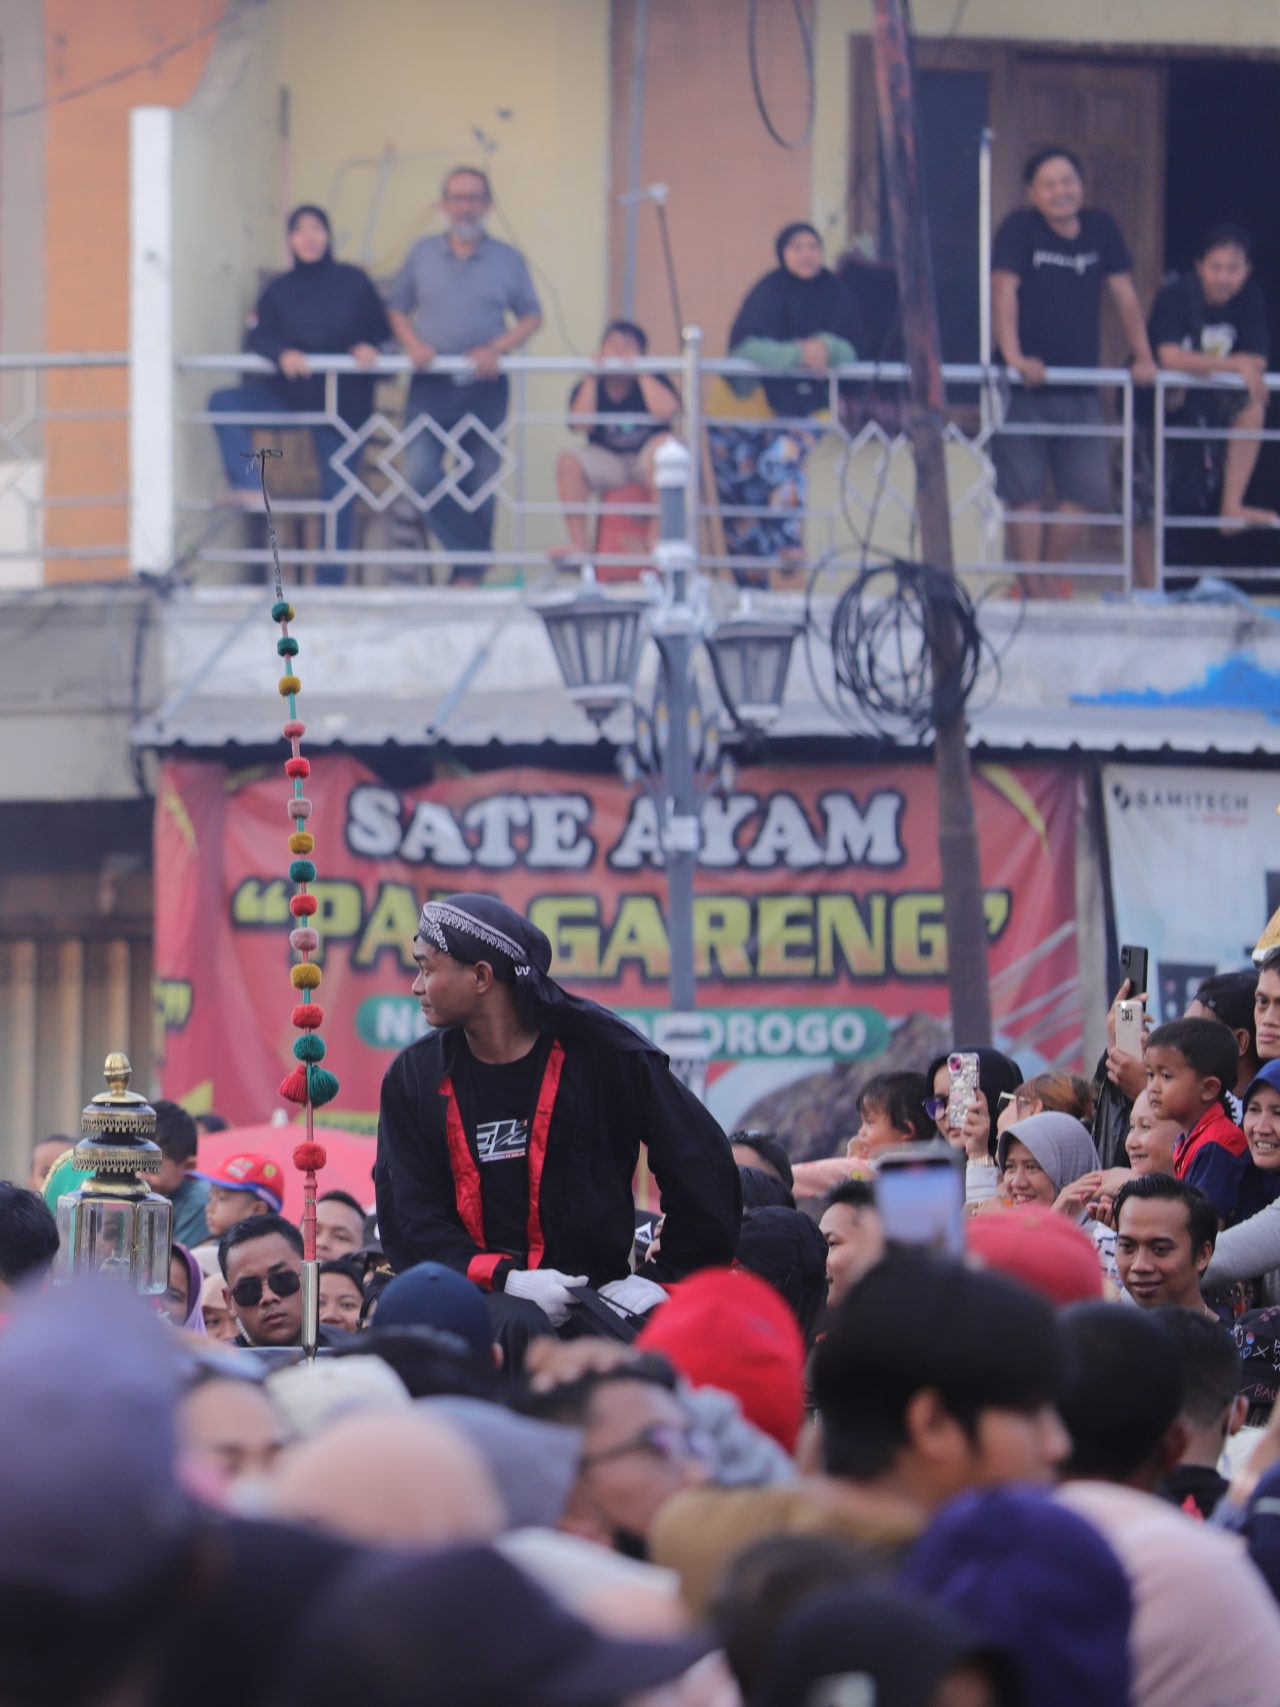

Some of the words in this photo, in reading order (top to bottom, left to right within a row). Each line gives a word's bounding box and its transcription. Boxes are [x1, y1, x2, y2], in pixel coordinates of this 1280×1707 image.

[346, 784, 596, 869] SATE
[608, 793, 905, 869] AYAM
[232, 879, 460, 968] “PA
